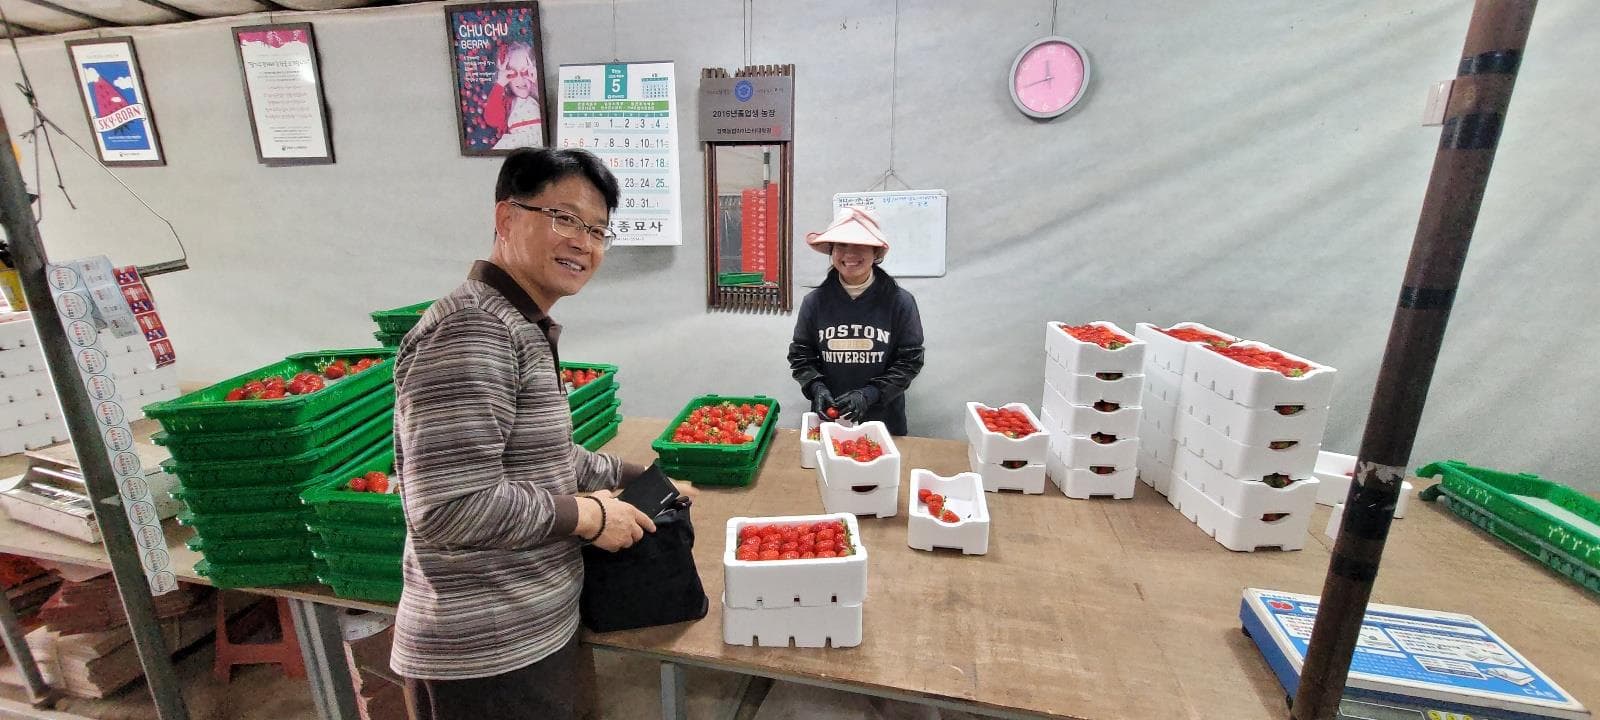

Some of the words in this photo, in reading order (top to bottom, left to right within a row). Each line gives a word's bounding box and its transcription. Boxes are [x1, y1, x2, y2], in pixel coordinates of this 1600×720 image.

[459, 24, 483, 38] CHU
[484, 22, 508, 37] CHU
[461, 39, 489, 49] BERRY
[611, 79, 621, 93] 5
[761, 109, 776, 118] 농장
[624, 118, 630, 128] 2
[640, 118, 646, 128] 3
[655, 118, 661, 128] 4
[563, 138, 569, 148] 5
[579, 138, 584, 148] 6
[594, 138, 599, 147] 7
[609, 138, 615, 148] 8
[624, 138, 630, 148] 9
[640, 138, 650, 148] 10
[656, 138, 664, 148] 11
[609, 157, 619, 168] 15
[624, 157, 634, 168] 16
[640, 157, 650, 168] 17
[655, 157, 665, 168] 18
[624, 177, 635, 188] 23
[640, 177, 650, 188] 24
[655, 178, 665, 188] 25
[625, 198, 635, 208] 30
[640, 198, 649, 208] 31
